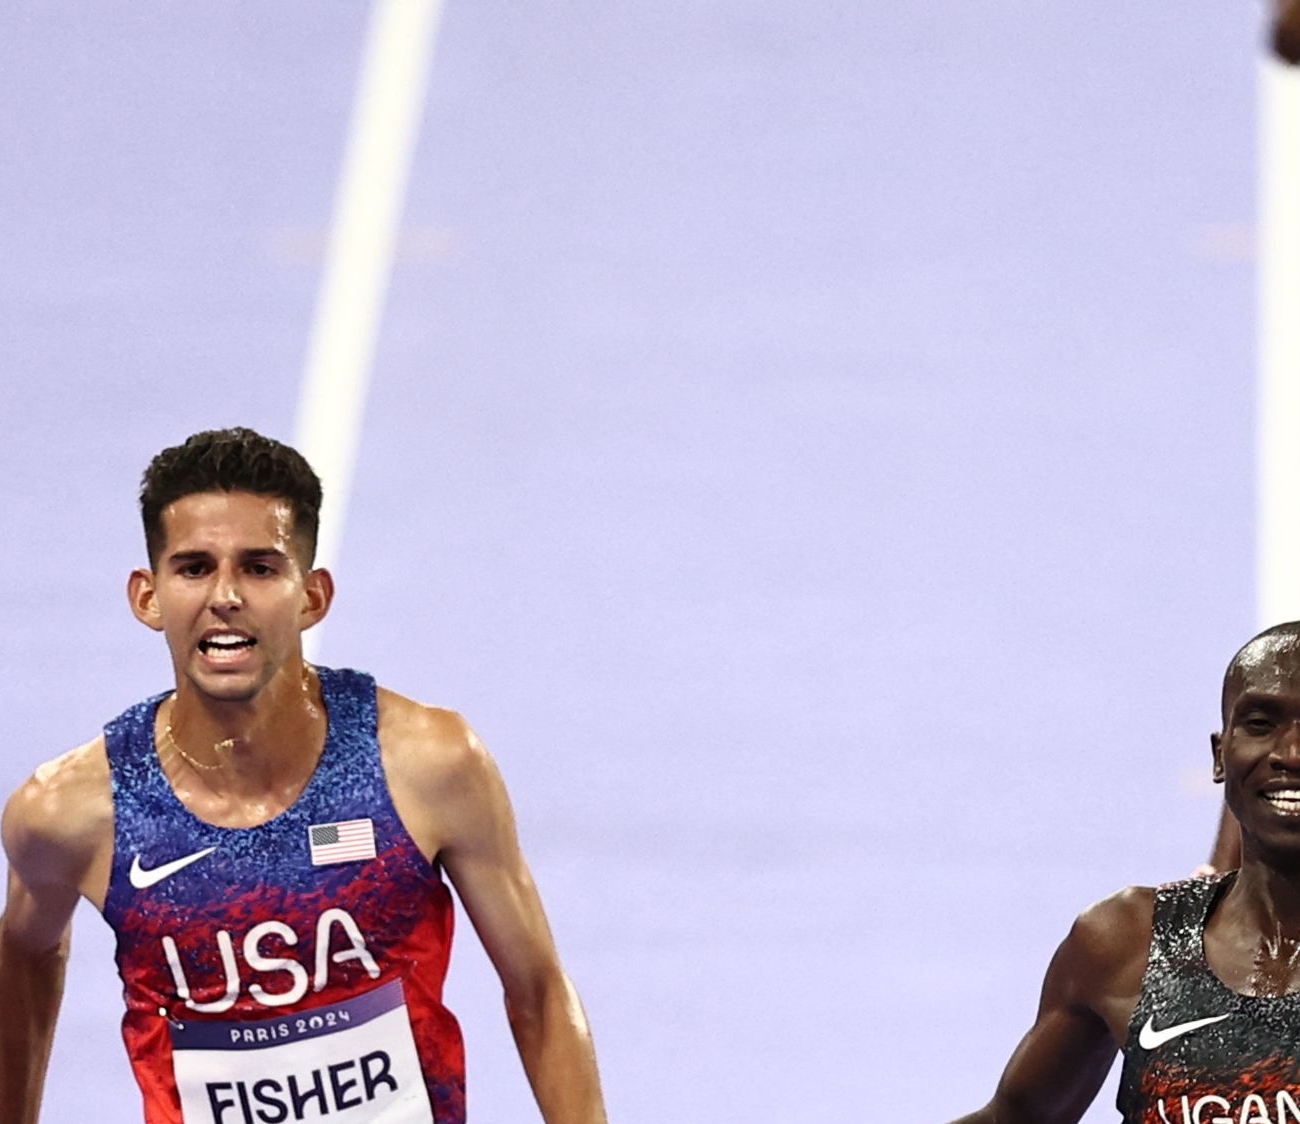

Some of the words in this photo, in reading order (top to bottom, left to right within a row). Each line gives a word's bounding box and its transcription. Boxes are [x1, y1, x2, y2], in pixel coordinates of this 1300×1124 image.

[161, 908, 381, 1013] USA
[230, 1023, 290, 1042] PARIS
[295, 1010, 350, 1033] 2024
